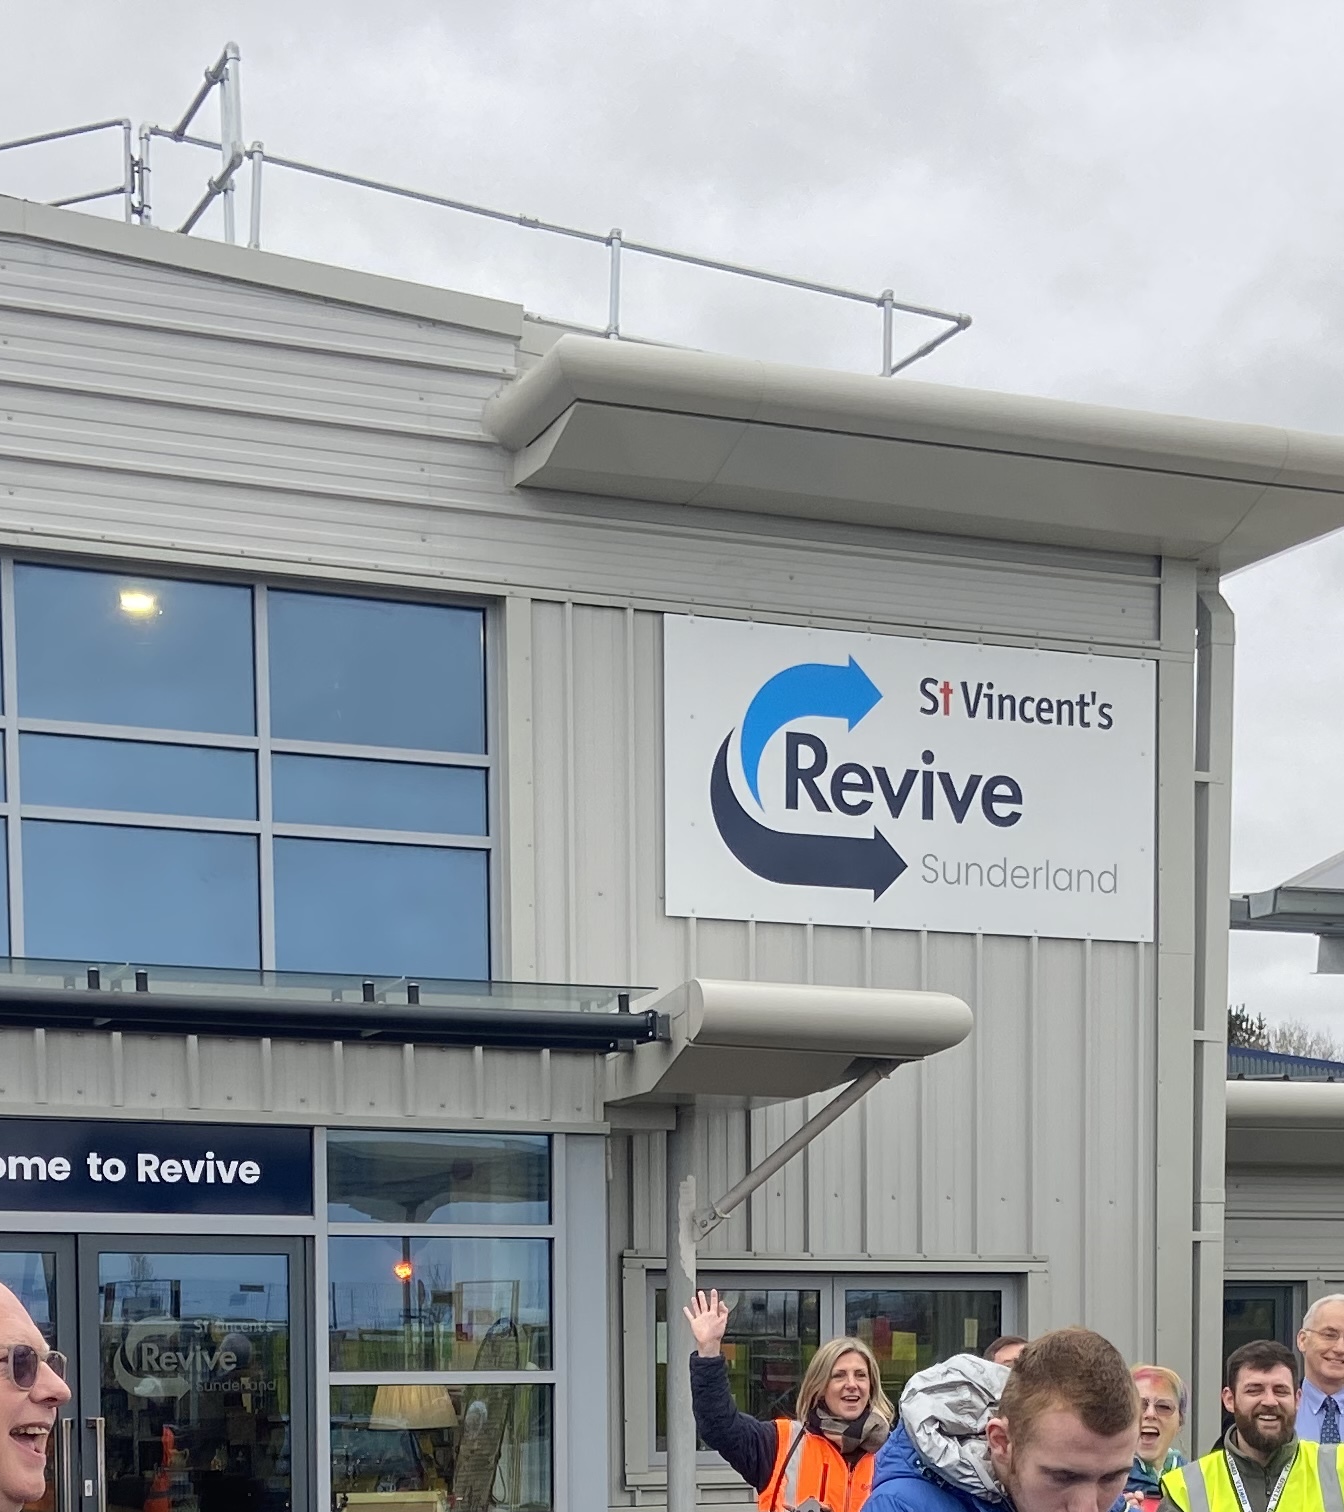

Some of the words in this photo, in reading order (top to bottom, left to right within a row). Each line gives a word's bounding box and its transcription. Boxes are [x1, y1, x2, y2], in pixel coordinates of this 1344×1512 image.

[920, 677, 954, 717] St
[960, 681, 1114, 730] Vincent's
[785, 731, 1023, 828] Revive
[921, 853, 1118, 893] Sunderland
[87, 1152, 126, 1182] to
[137, 1151, 261, 1185] Revive
[141, 1342, 238, 1372] Revive
